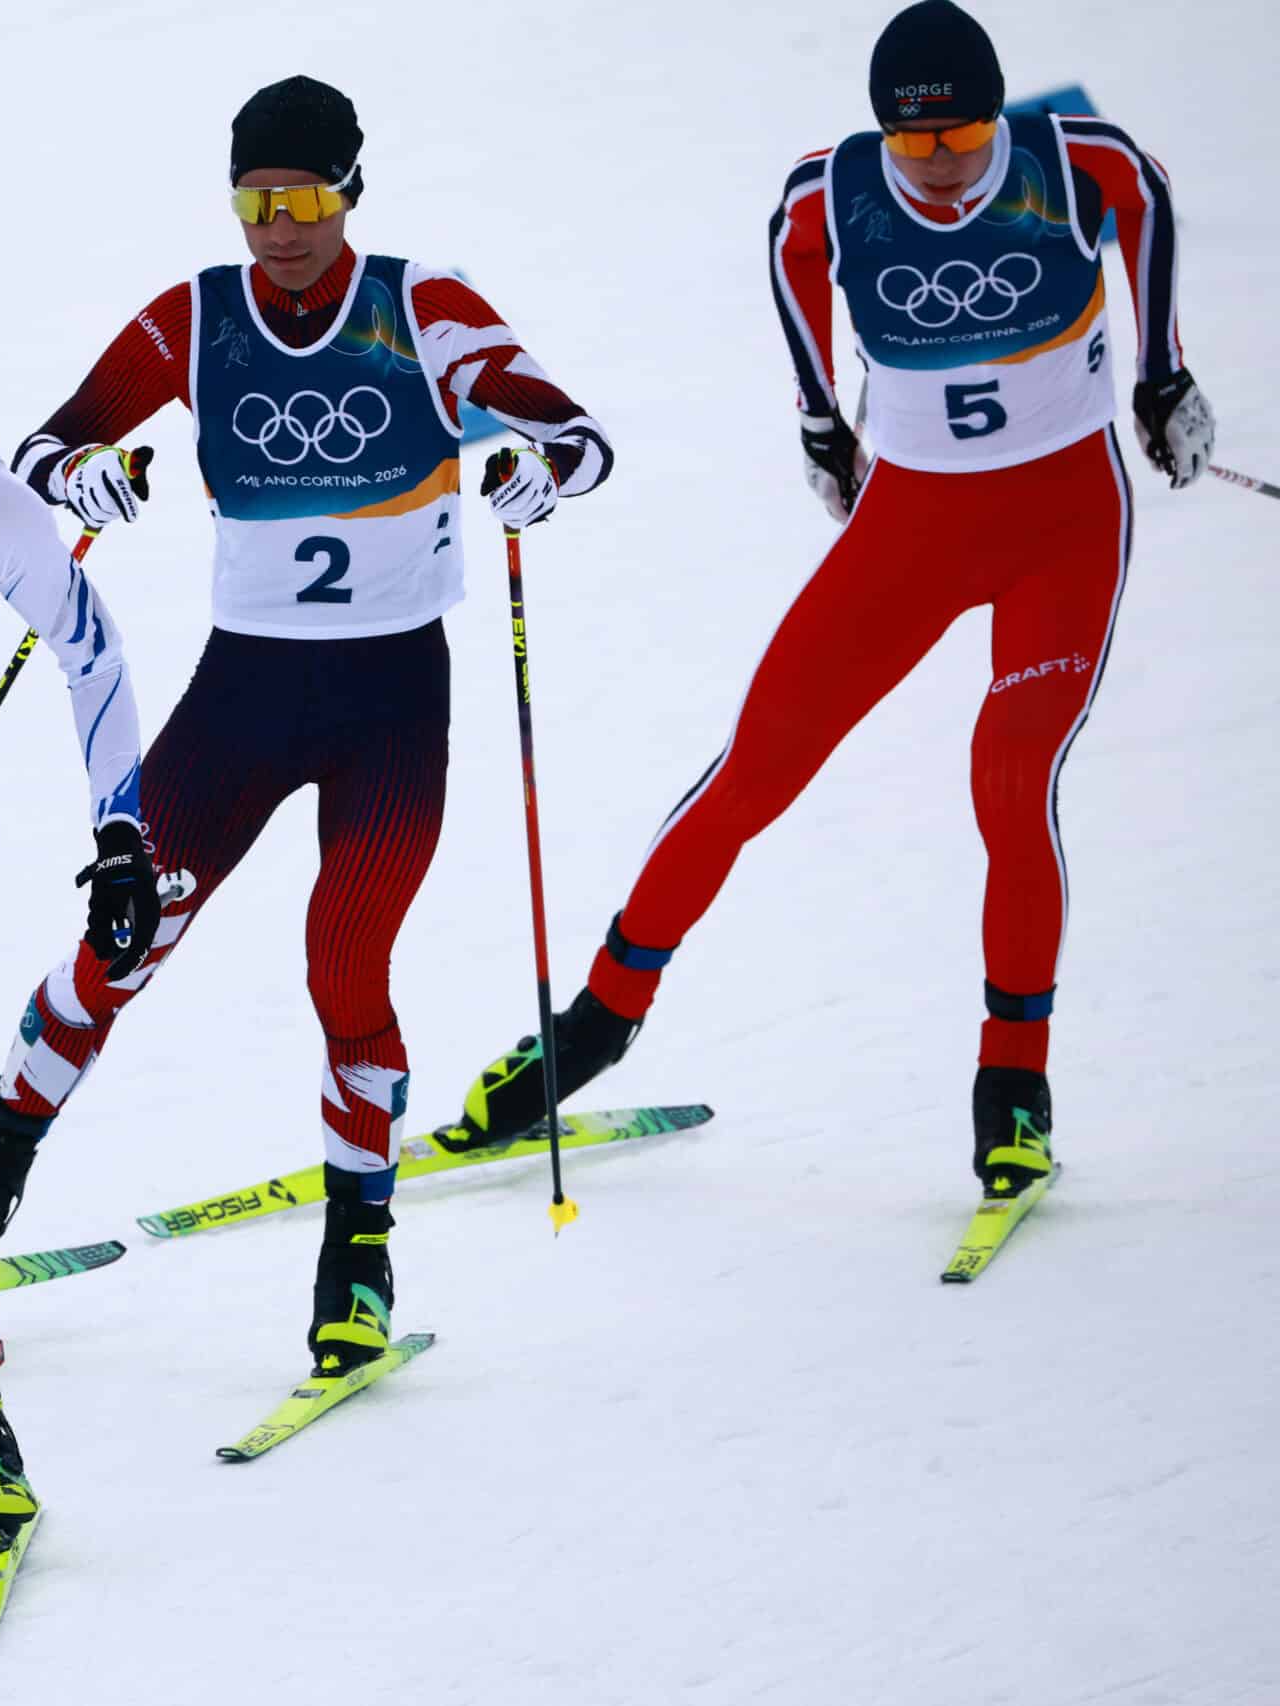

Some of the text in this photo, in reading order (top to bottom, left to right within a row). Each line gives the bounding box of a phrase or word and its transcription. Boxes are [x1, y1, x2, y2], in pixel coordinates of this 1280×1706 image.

[894, 83, 953, 98] NORGE
[881, 313, 1061, 346] MILANO CORTINA 2026
[943, 378, 1008, 441] 5
[236, 465, 408, 488] MILANO CORTINA 2026
[294, 535, 353, 604] 2
[991, 658, 1071, 694] CRAFT
[165, 1191, 262, 1232] FISCHER
